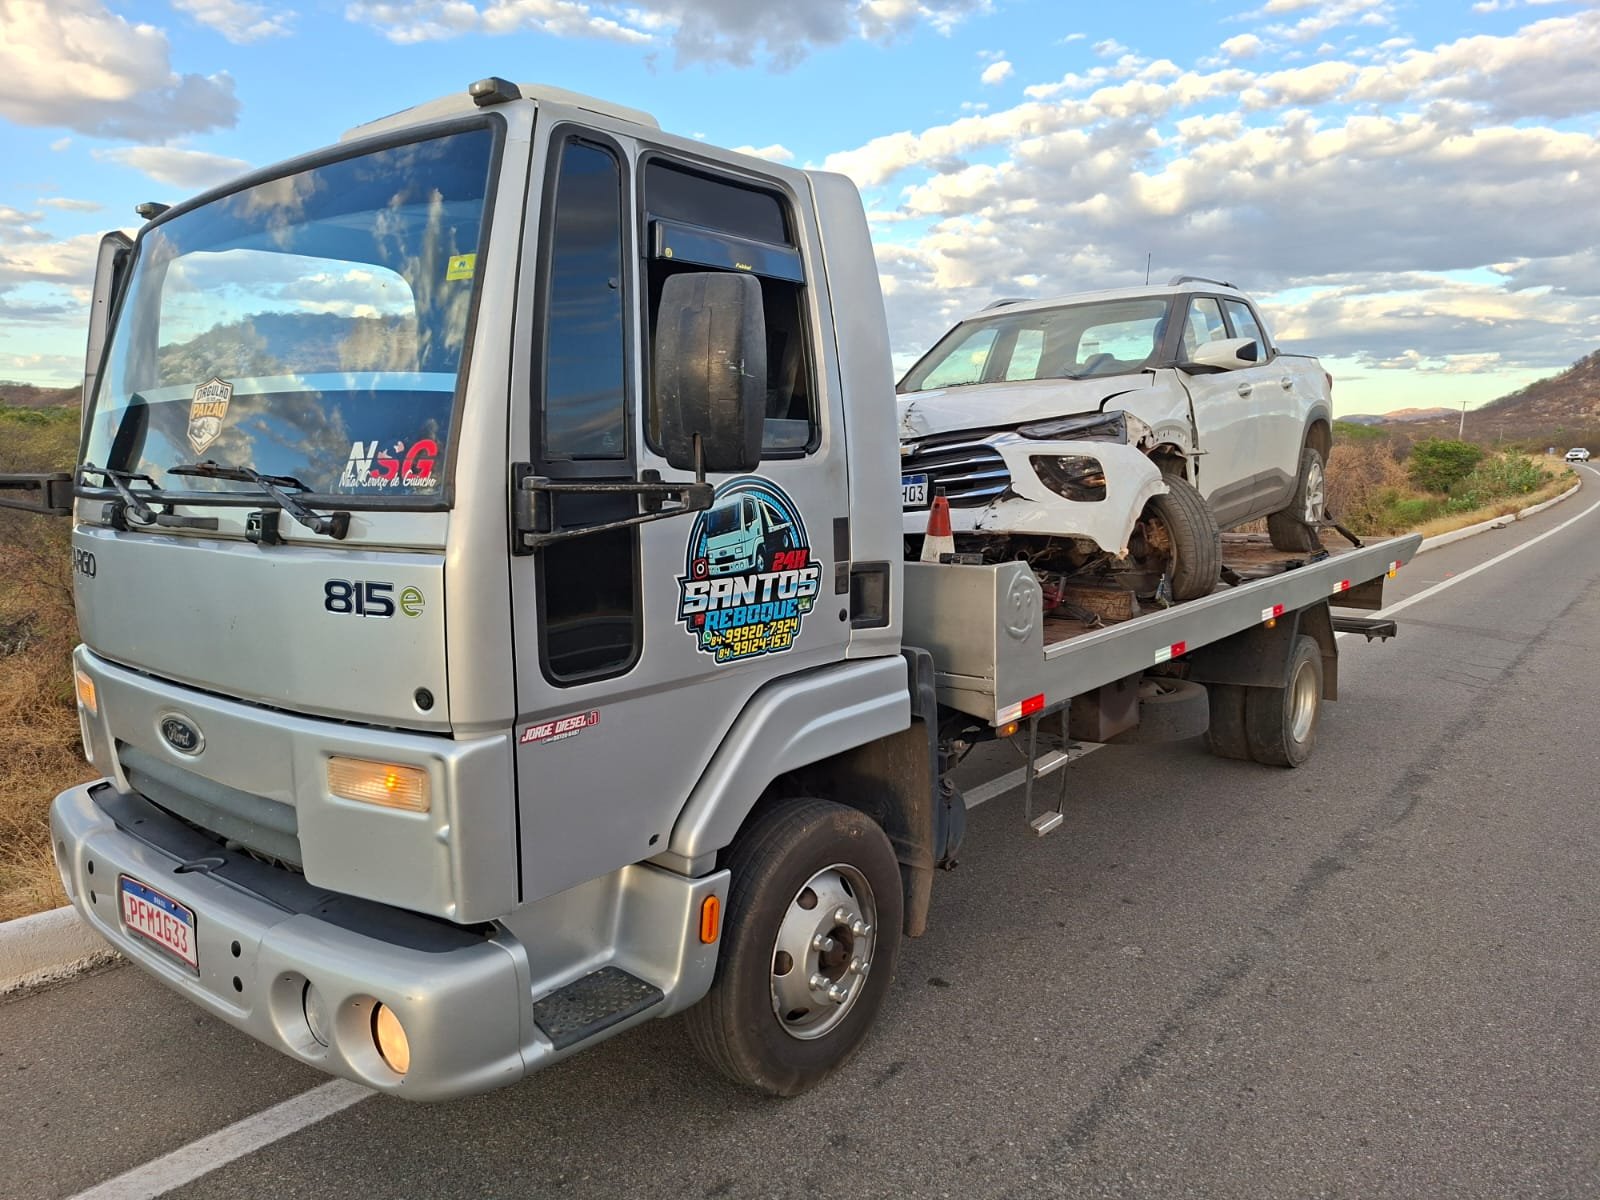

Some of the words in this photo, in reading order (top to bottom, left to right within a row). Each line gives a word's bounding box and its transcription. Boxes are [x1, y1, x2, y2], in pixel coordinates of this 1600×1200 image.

[197, 384, 229, 400] ORGULHO
[390, 471, 400, 488] de
[402, 468, 437, 488] Guincho
[773, 550, 808, 571] 24H
[683, 567, 819, 614] SANTOS
[704, 598, 799, 632] REBOQUE
[168, 721, 191, 747] Ford
[521, 723, 554, 742] JORGE
[555, 715, 586, 733] DIESEL
[129, 897, 187, 953] PFM1G33
